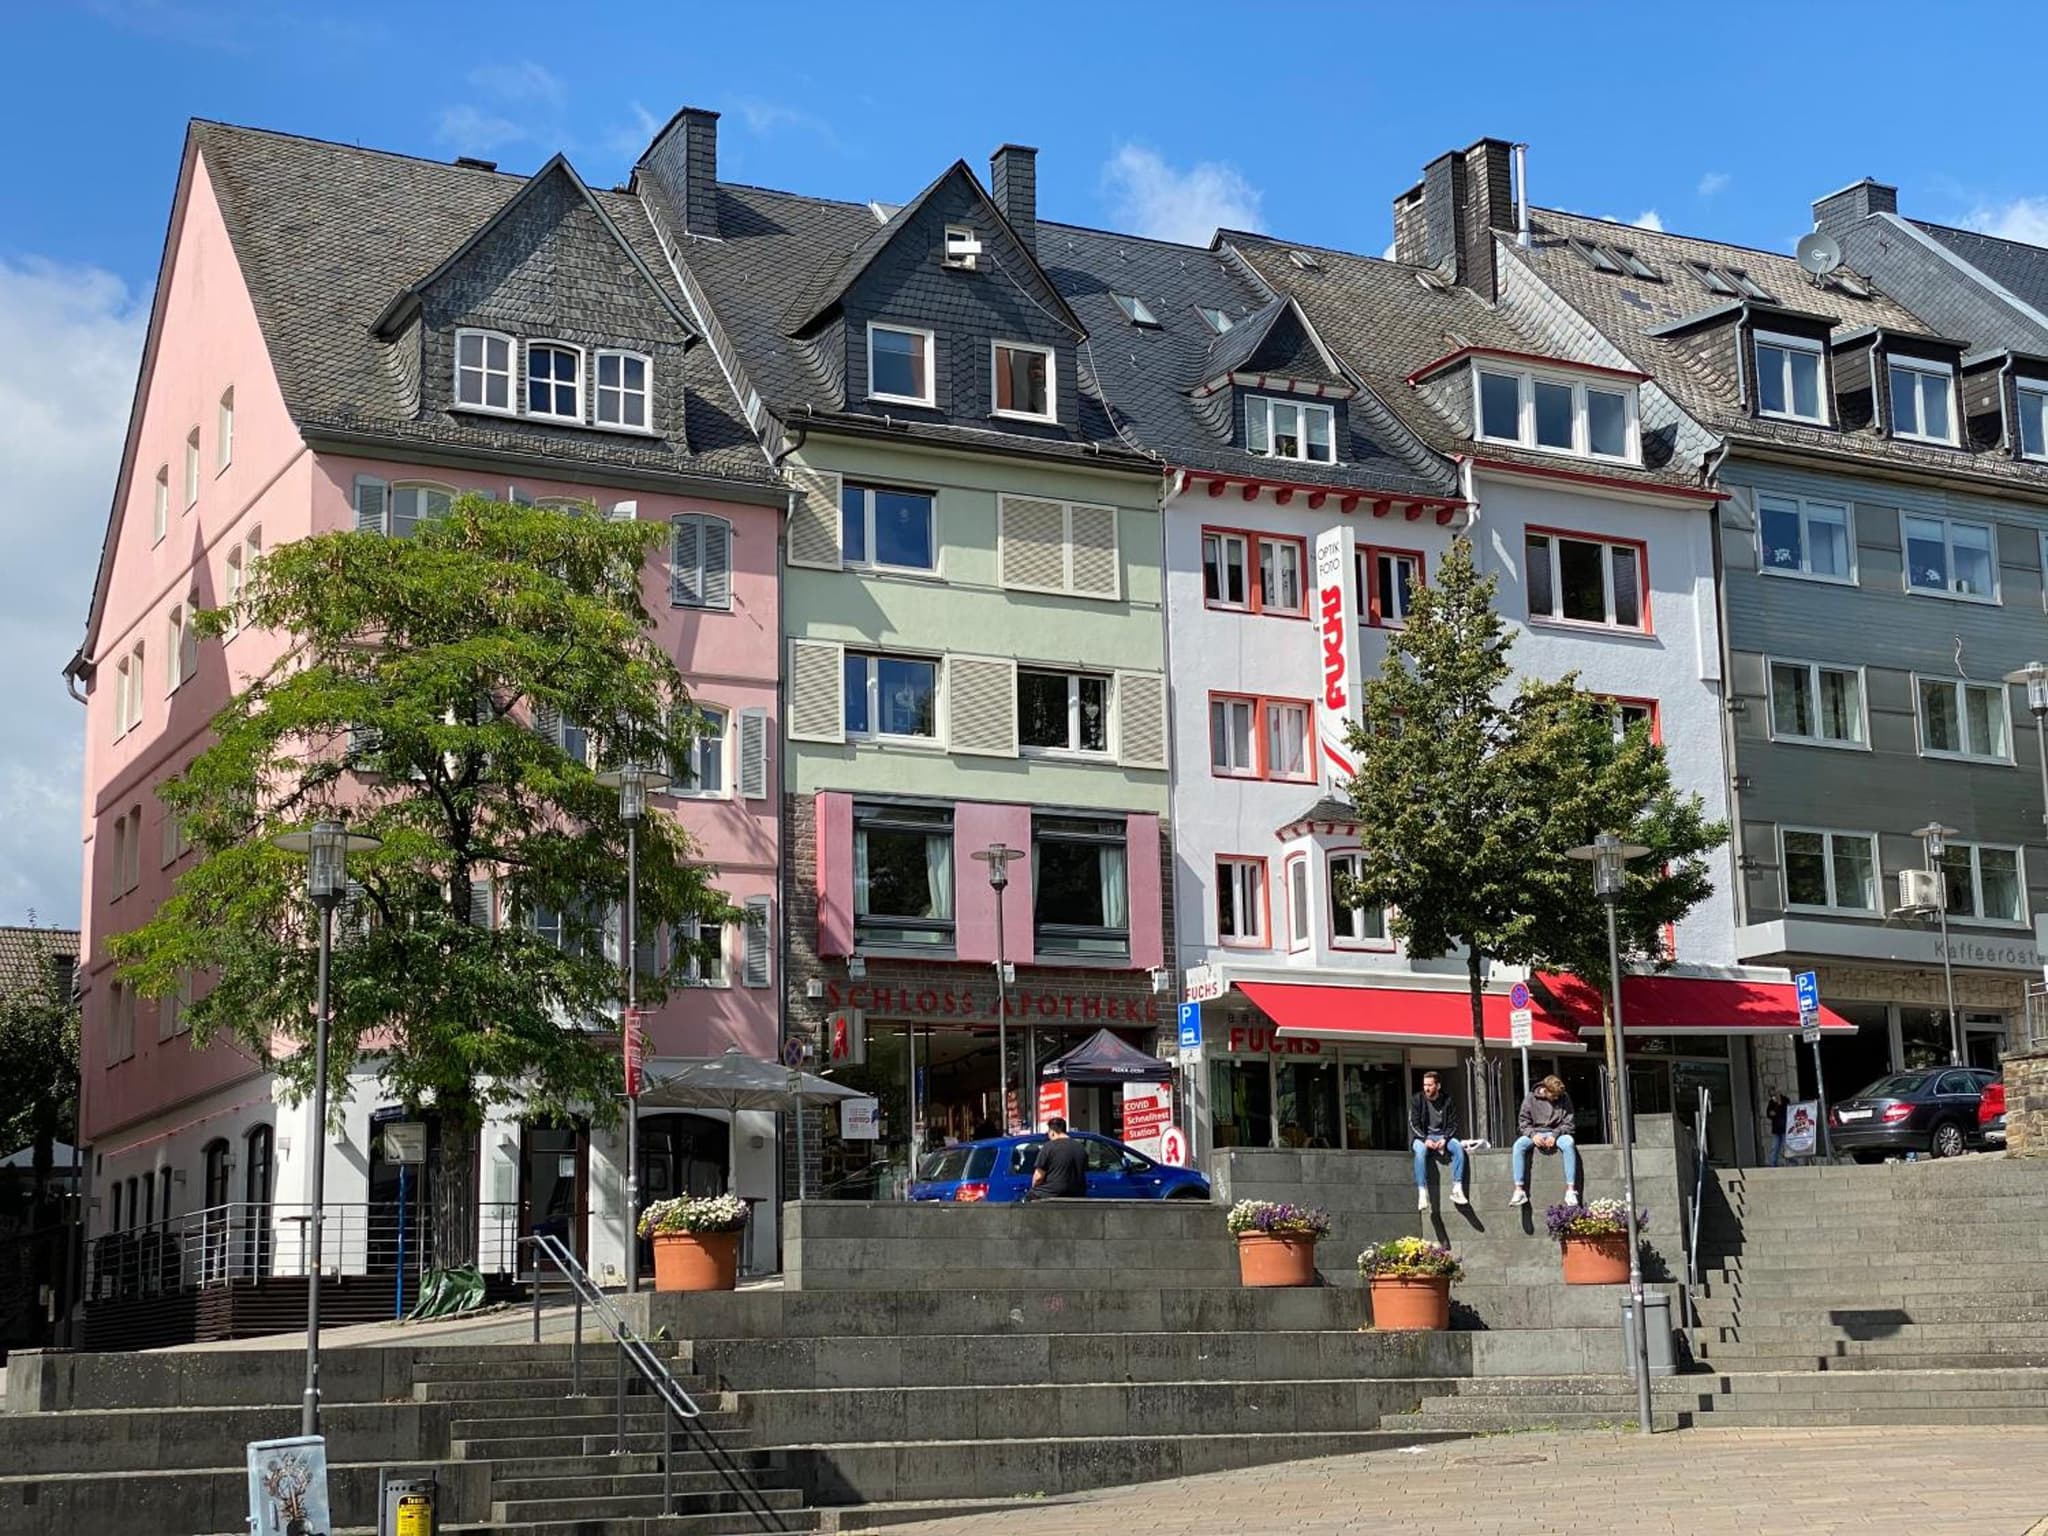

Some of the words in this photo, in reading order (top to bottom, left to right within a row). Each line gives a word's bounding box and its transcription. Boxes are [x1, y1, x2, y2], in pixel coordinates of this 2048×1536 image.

[1318, 542, 1340, 561] OPTIK
[1319, 558, 1340, 576] FOTO
[1321, 585, 1346, 710] FUCHS
[1185, 982, 1218, 1000] FUCHS
[1798, 976, 1808, 993] P
[826, 979, 975, 1015] SCHLOSS
[988, 989, 1157, 1022] APOTHEKE
[1181, 1006, 1192, 1025] P
[1229, 1027, 1321, 1054] FUCHS
[1124, 1099, 1150, 1111] COVID
[1127, 1111, 1169, 1125] Schnelltest
[1129, 1127, 1156, 1138] Station
